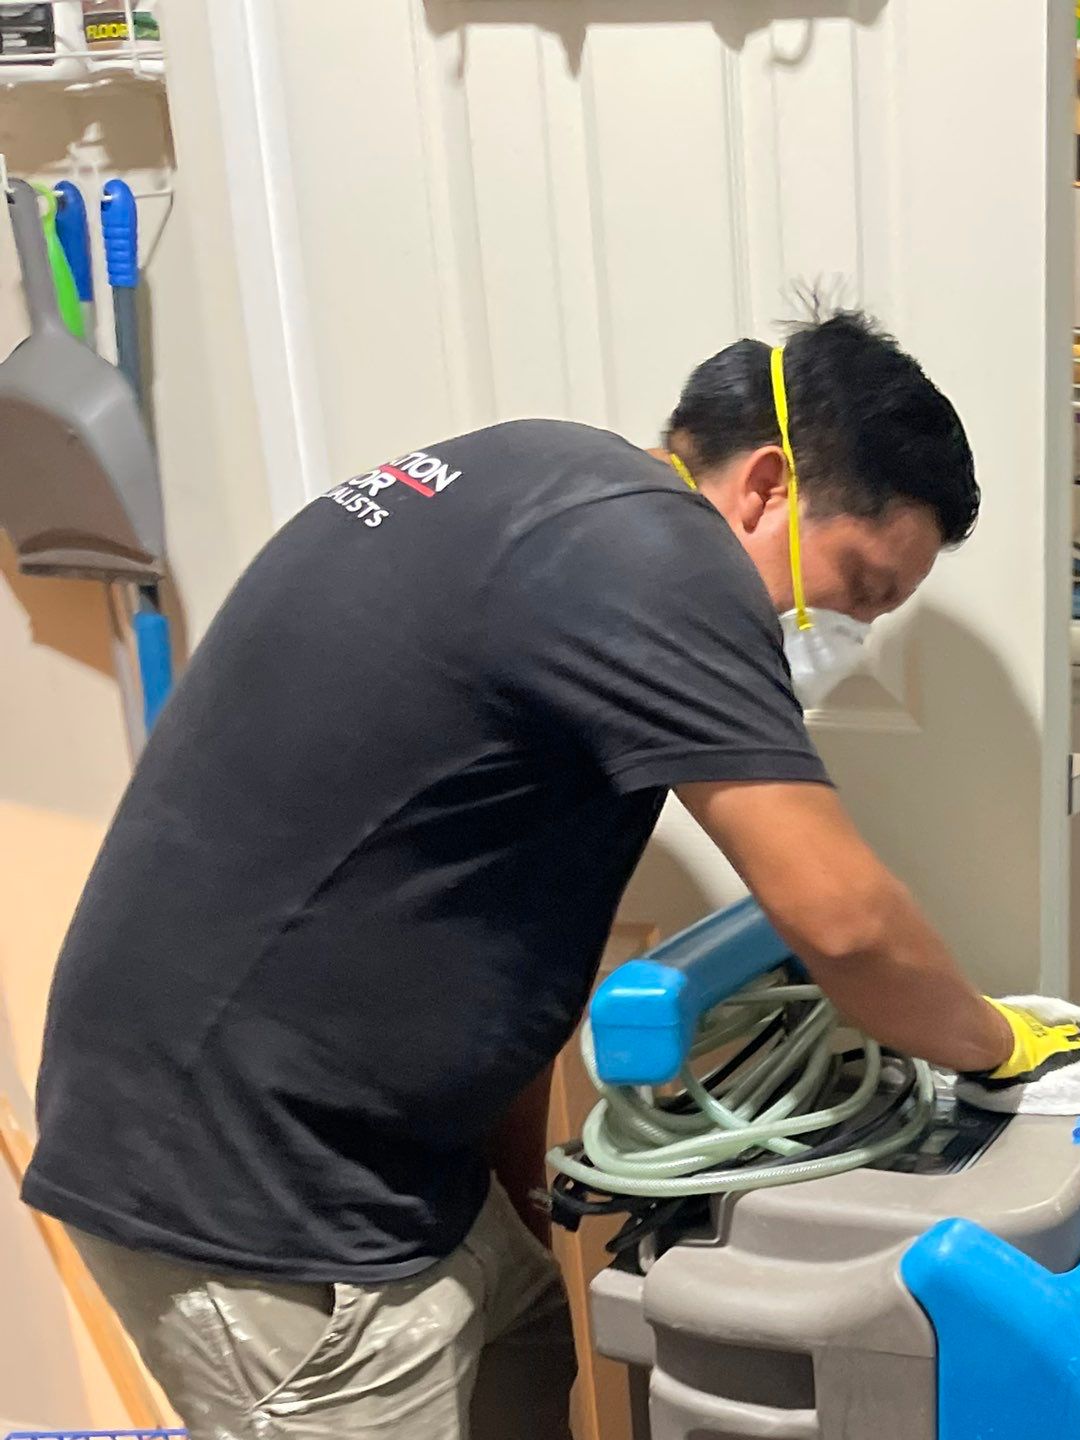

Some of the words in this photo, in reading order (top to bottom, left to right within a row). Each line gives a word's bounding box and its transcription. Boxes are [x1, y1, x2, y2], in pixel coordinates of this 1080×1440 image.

[348, 469, 398, 497] OR
[386, 451, 462, 493] TION
[326, 486, 390, 528] ALISTS
